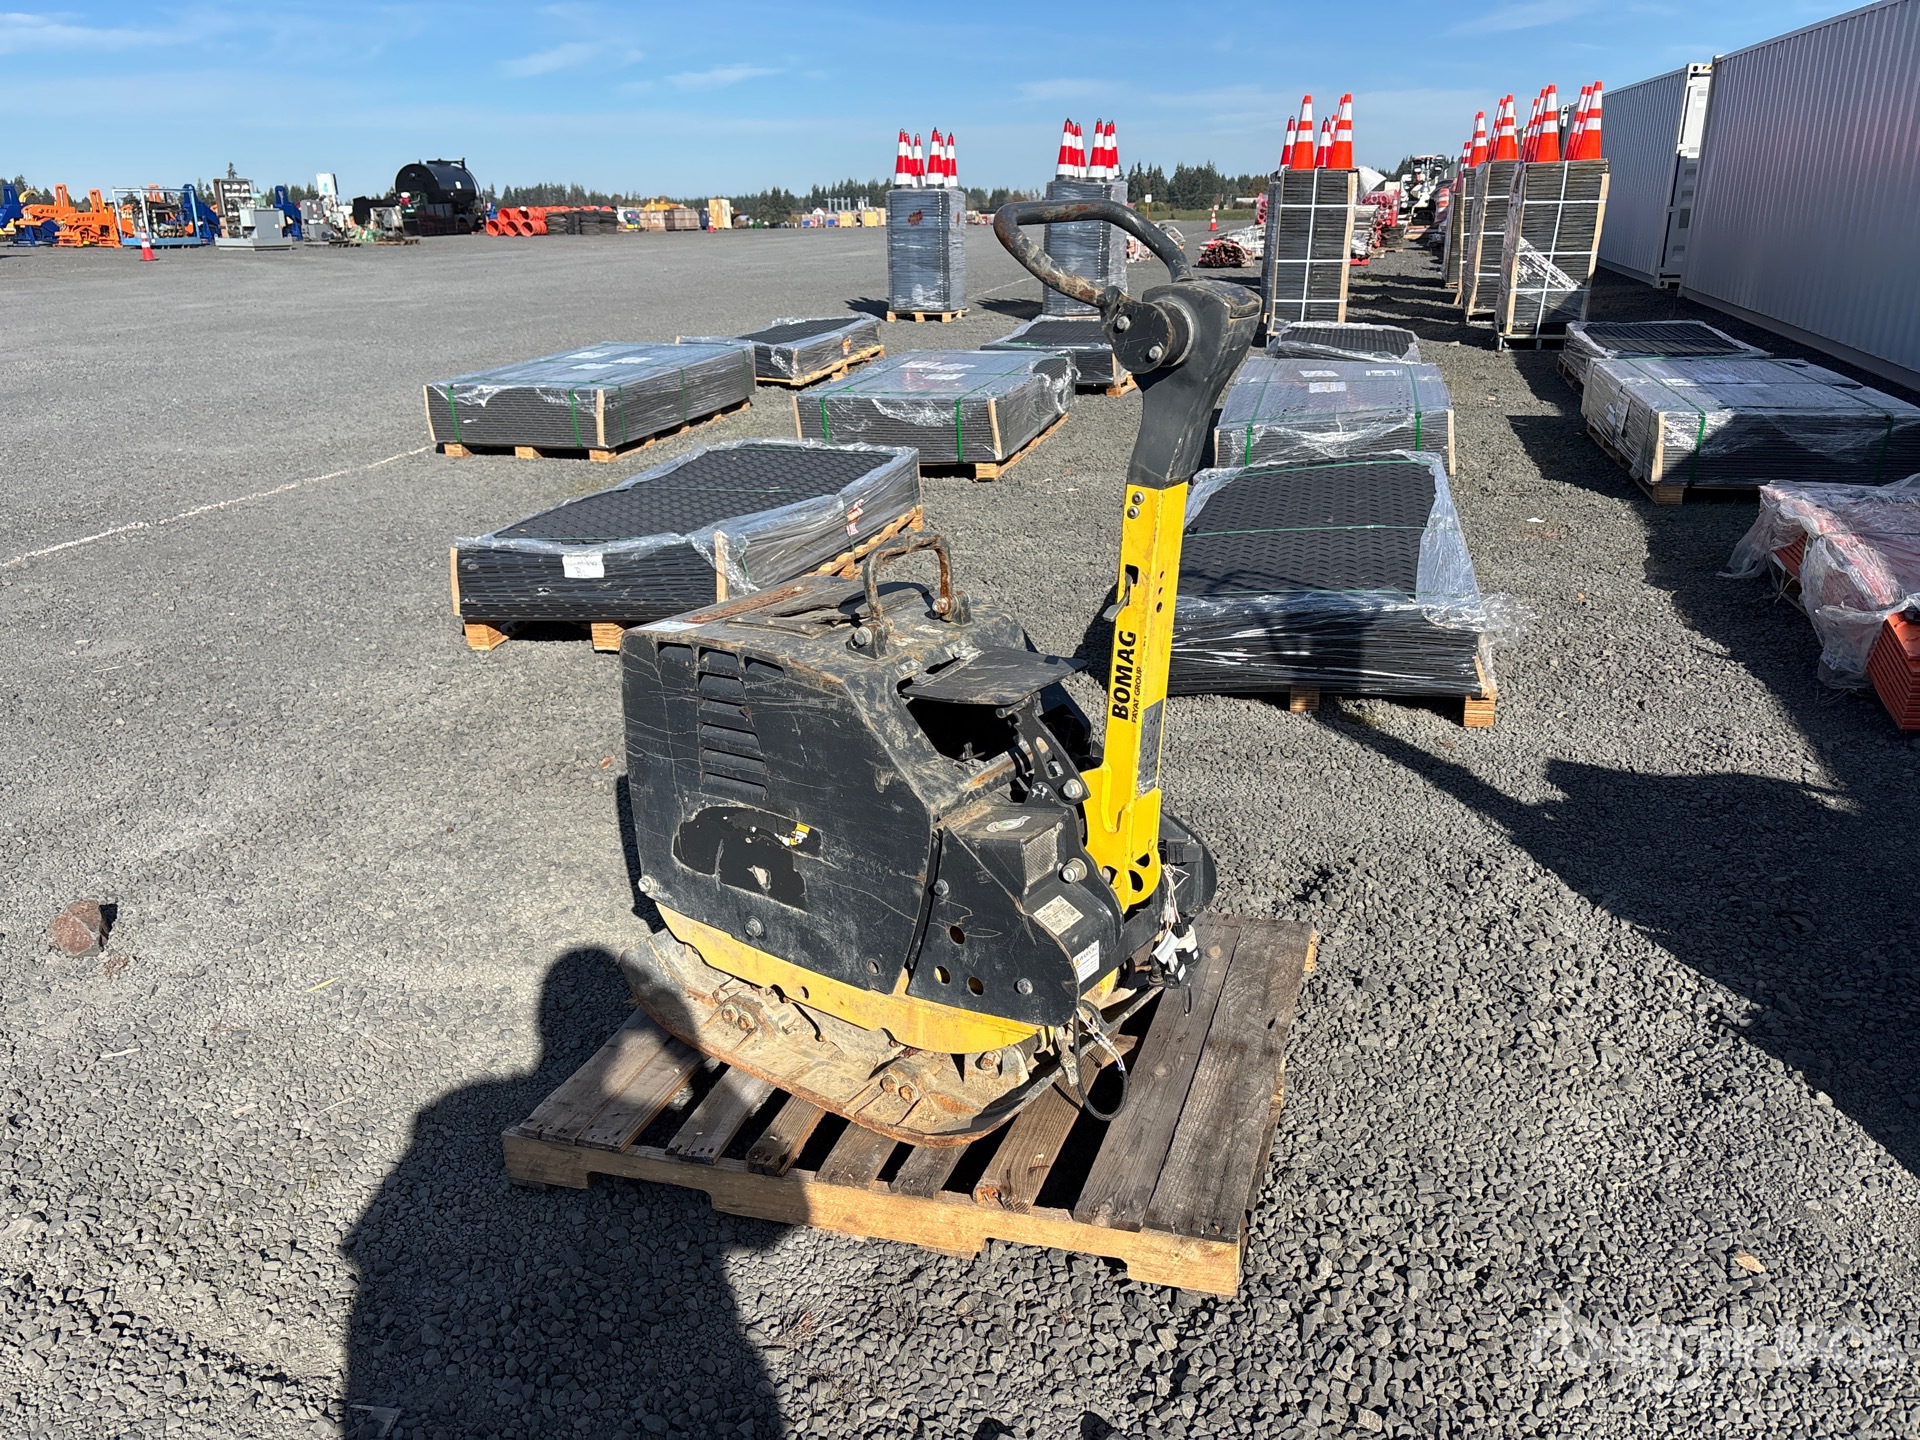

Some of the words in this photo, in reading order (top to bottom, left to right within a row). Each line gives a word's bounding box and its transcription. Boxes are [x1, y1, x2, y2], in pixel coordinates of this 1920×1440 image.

[1112, 630, 1137, 720] BOMAG
[1131, 699, 1139, 723] FAYAT
[1135, 666, 1143, 695] GROUP
